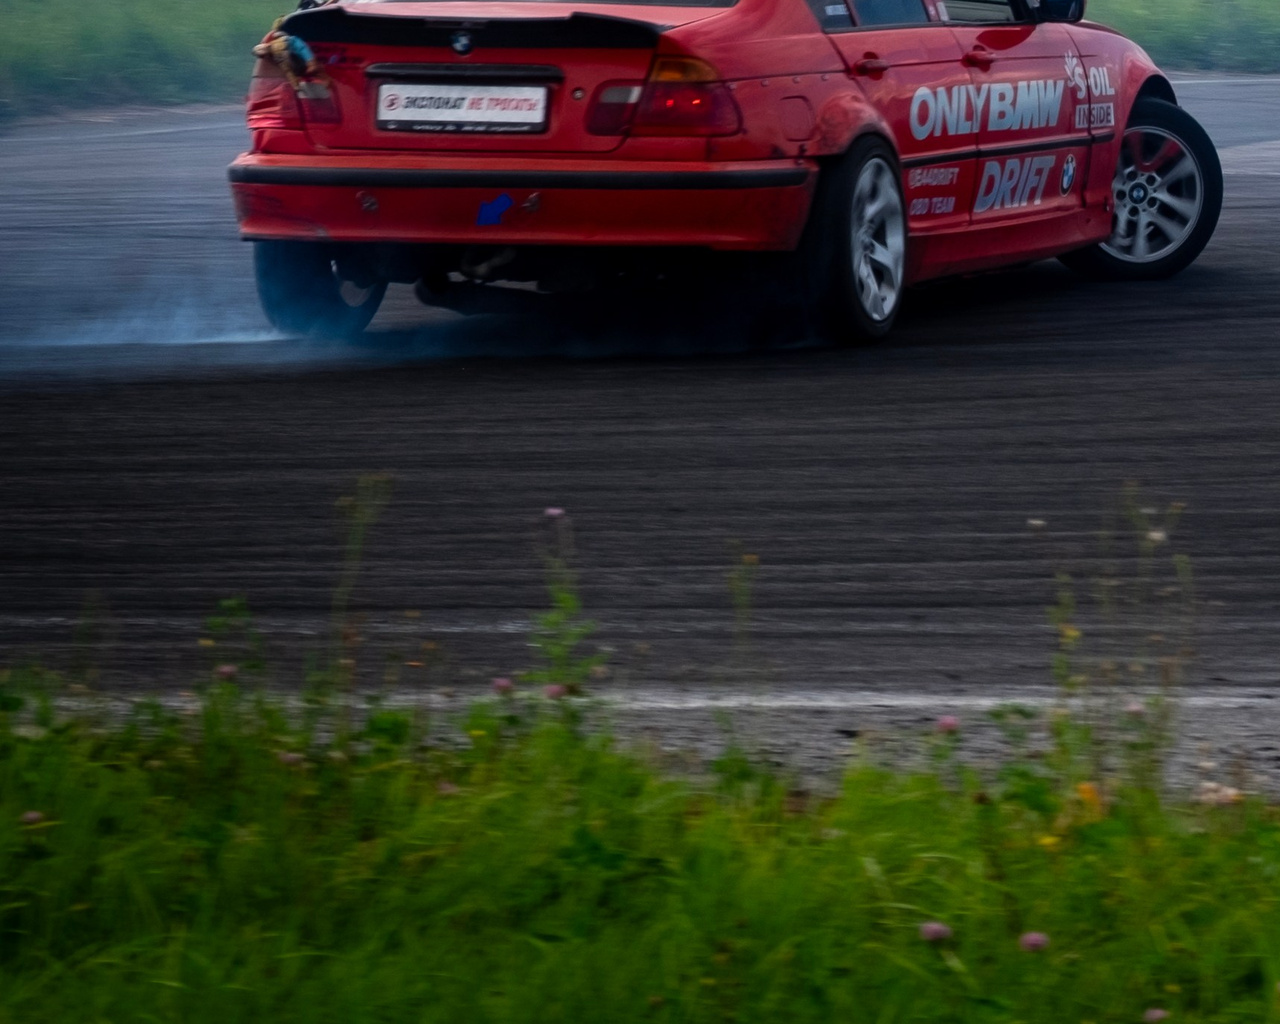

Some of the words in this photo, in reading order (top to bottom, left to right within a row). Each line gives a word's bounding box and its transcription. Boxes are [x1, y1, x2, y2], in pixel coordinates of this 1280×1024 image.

[403, 96, 468, 110] ЭКСПОНАТ
[467, 97, 484, 111] НЕ
[910, 79, 1065, 141] ONLYBMW
[1077, 104, 1112, 126] INSIDE
[973, 155, 1056, 214] DRIFT
[931, 196, 956, 214] TEAM
